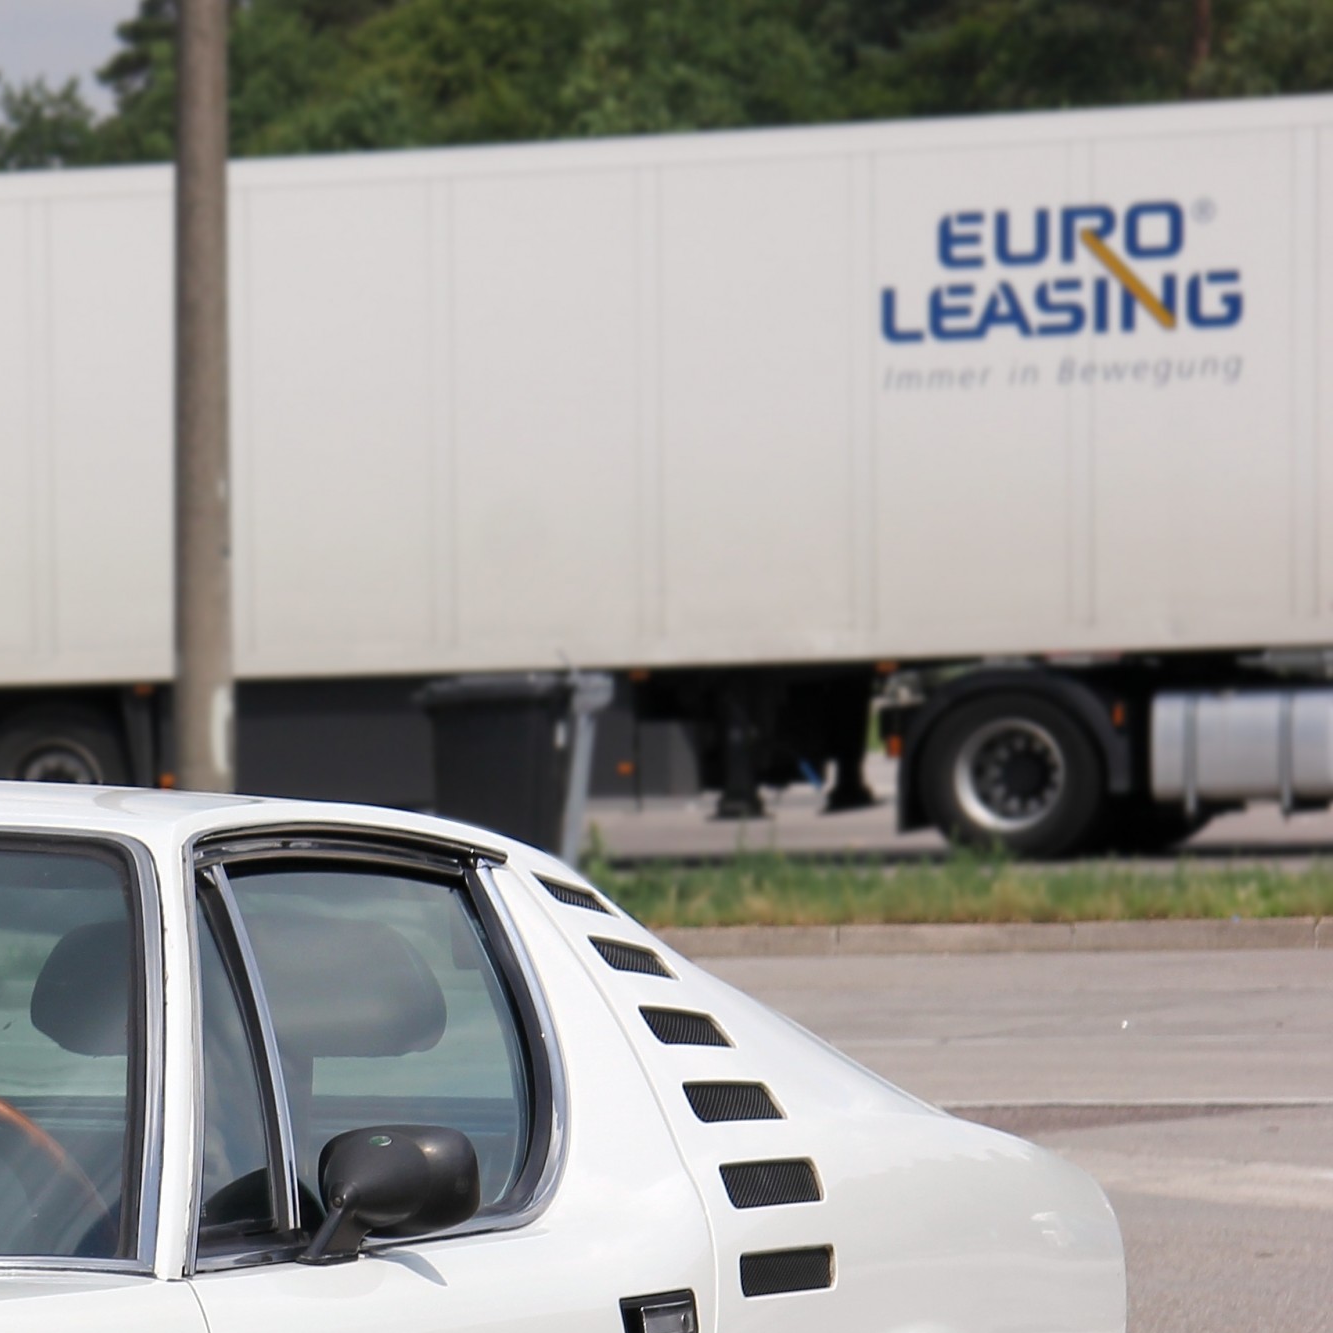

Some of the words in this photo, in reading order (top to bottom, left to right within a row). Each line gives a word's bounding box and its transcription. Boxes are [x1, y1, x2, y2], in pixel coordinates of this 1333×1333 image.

[937, 200, 1184, 270] EURO
[880, 269, 1244, 344] LEASING
[883, 366, 991, 392] Immer
[1008, 360, 1040, 386] in
[1056, 353, 1245, 390] Bewegung
